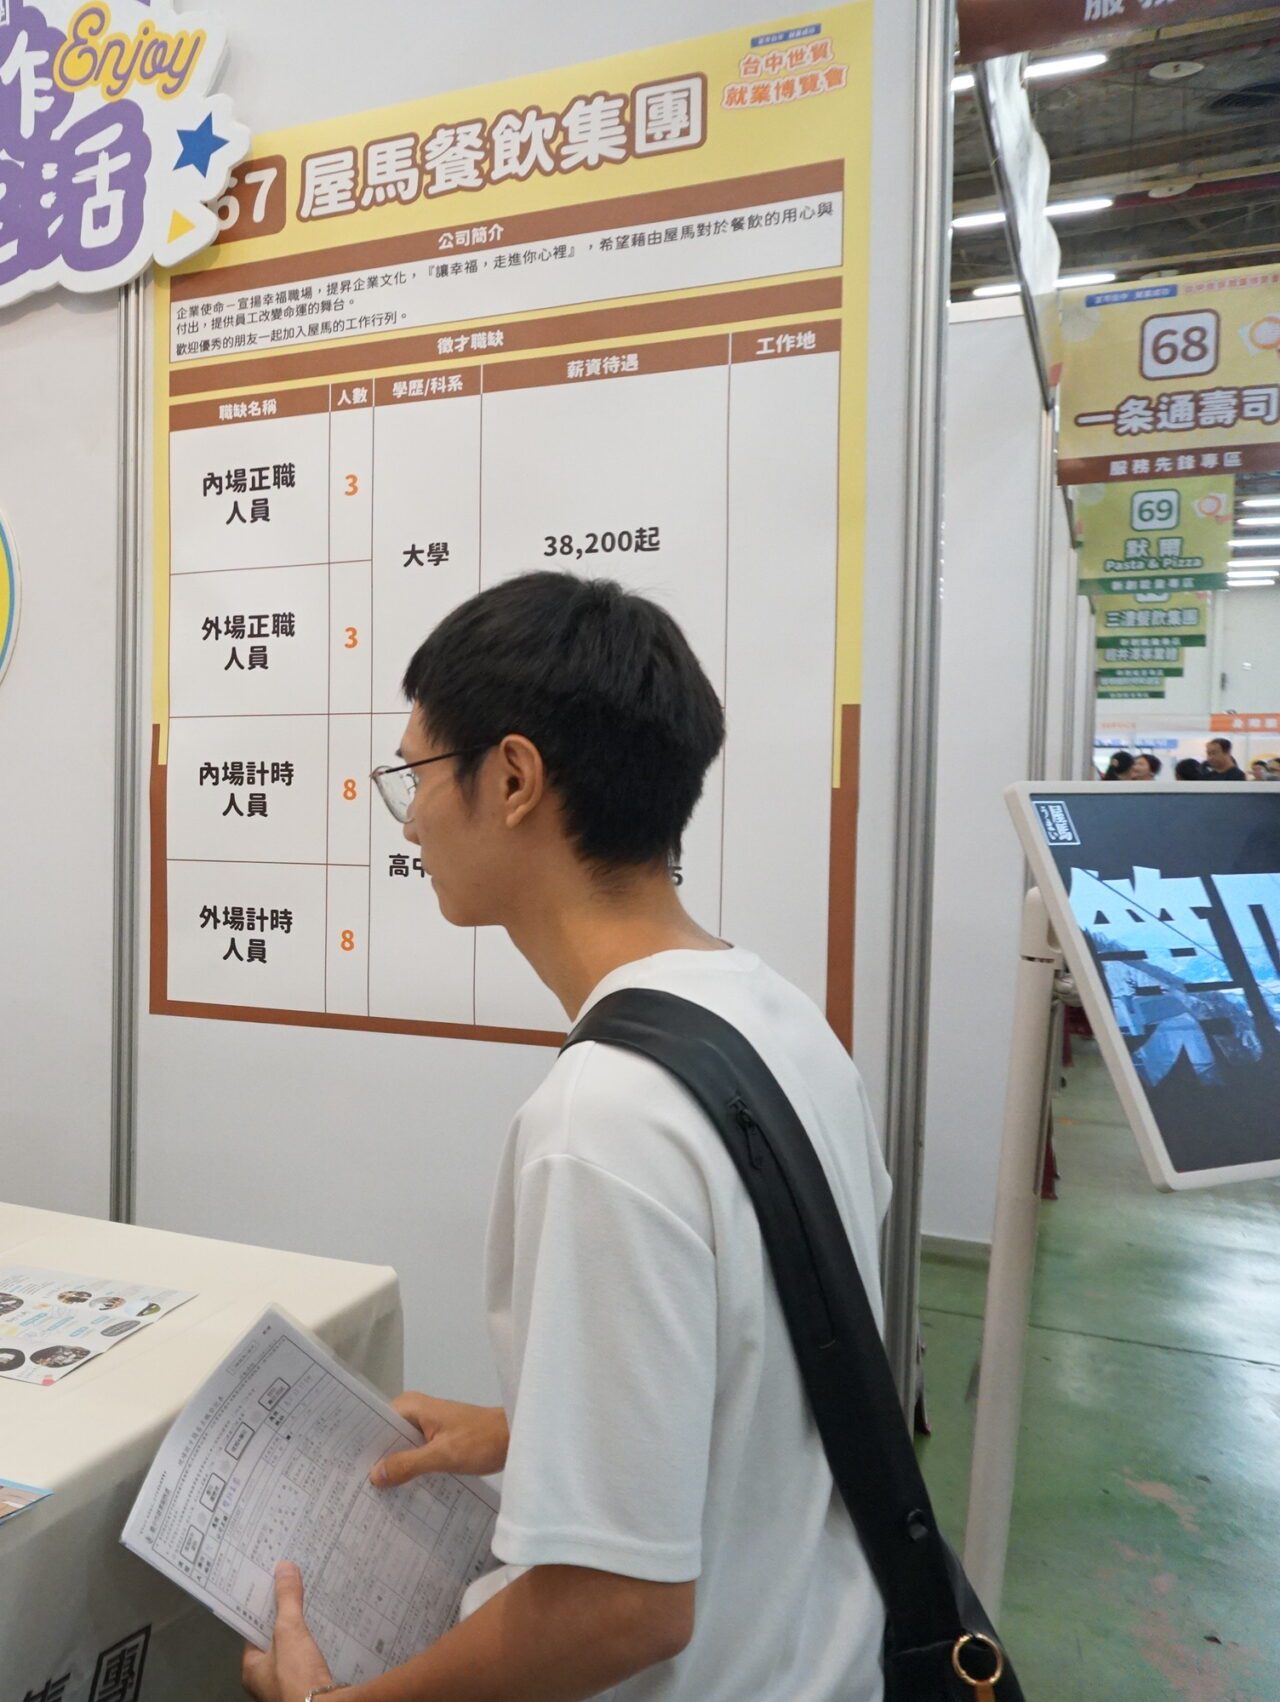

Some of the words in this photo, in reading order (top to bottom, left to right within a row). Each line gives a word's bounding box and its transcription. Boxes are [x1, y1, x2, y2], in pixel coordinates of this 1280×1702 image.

[57, 5, 203, 97] Enjoy
[300, 74, 703, 220] 屋馬餐飲集團
[437, 222, 504, 250] 公司簡介
[437, 330, 504, 355] 徵才職缺
[755, 331, 816, 355] 工作地
[1151, 325, 1209, 364] 68
[566, 353, 639, 379] 薪資待遇
[337, 386, 367, 406] 人數
[392, 375, 463, 399] 學歷/科系
[218, 399, 277, 421] 職缺名稱
[201, 462, 297, 497] 內場正職
[344, 474, 358, 497] 3
[225, 498, 271, 525] 人員
[1137, 499, 1173, 522] 69
[402, 542, 450, 568] 大學
[542, 526, 661, 559] 38,200起
[201, 612, 296, 641] 外場正職
[344, 627, 358, 649] 3
[223, 646, 269, 672] 人員
[198, 761, 295, 787] 內場計時
[342, 778, 357, 801] 8
[221, 793, 269, 819] 人員
[199, 906, 293, 934] 外場計時
[222, 938, 268, 964] 人員
[340, 929, 355, 952] 8
